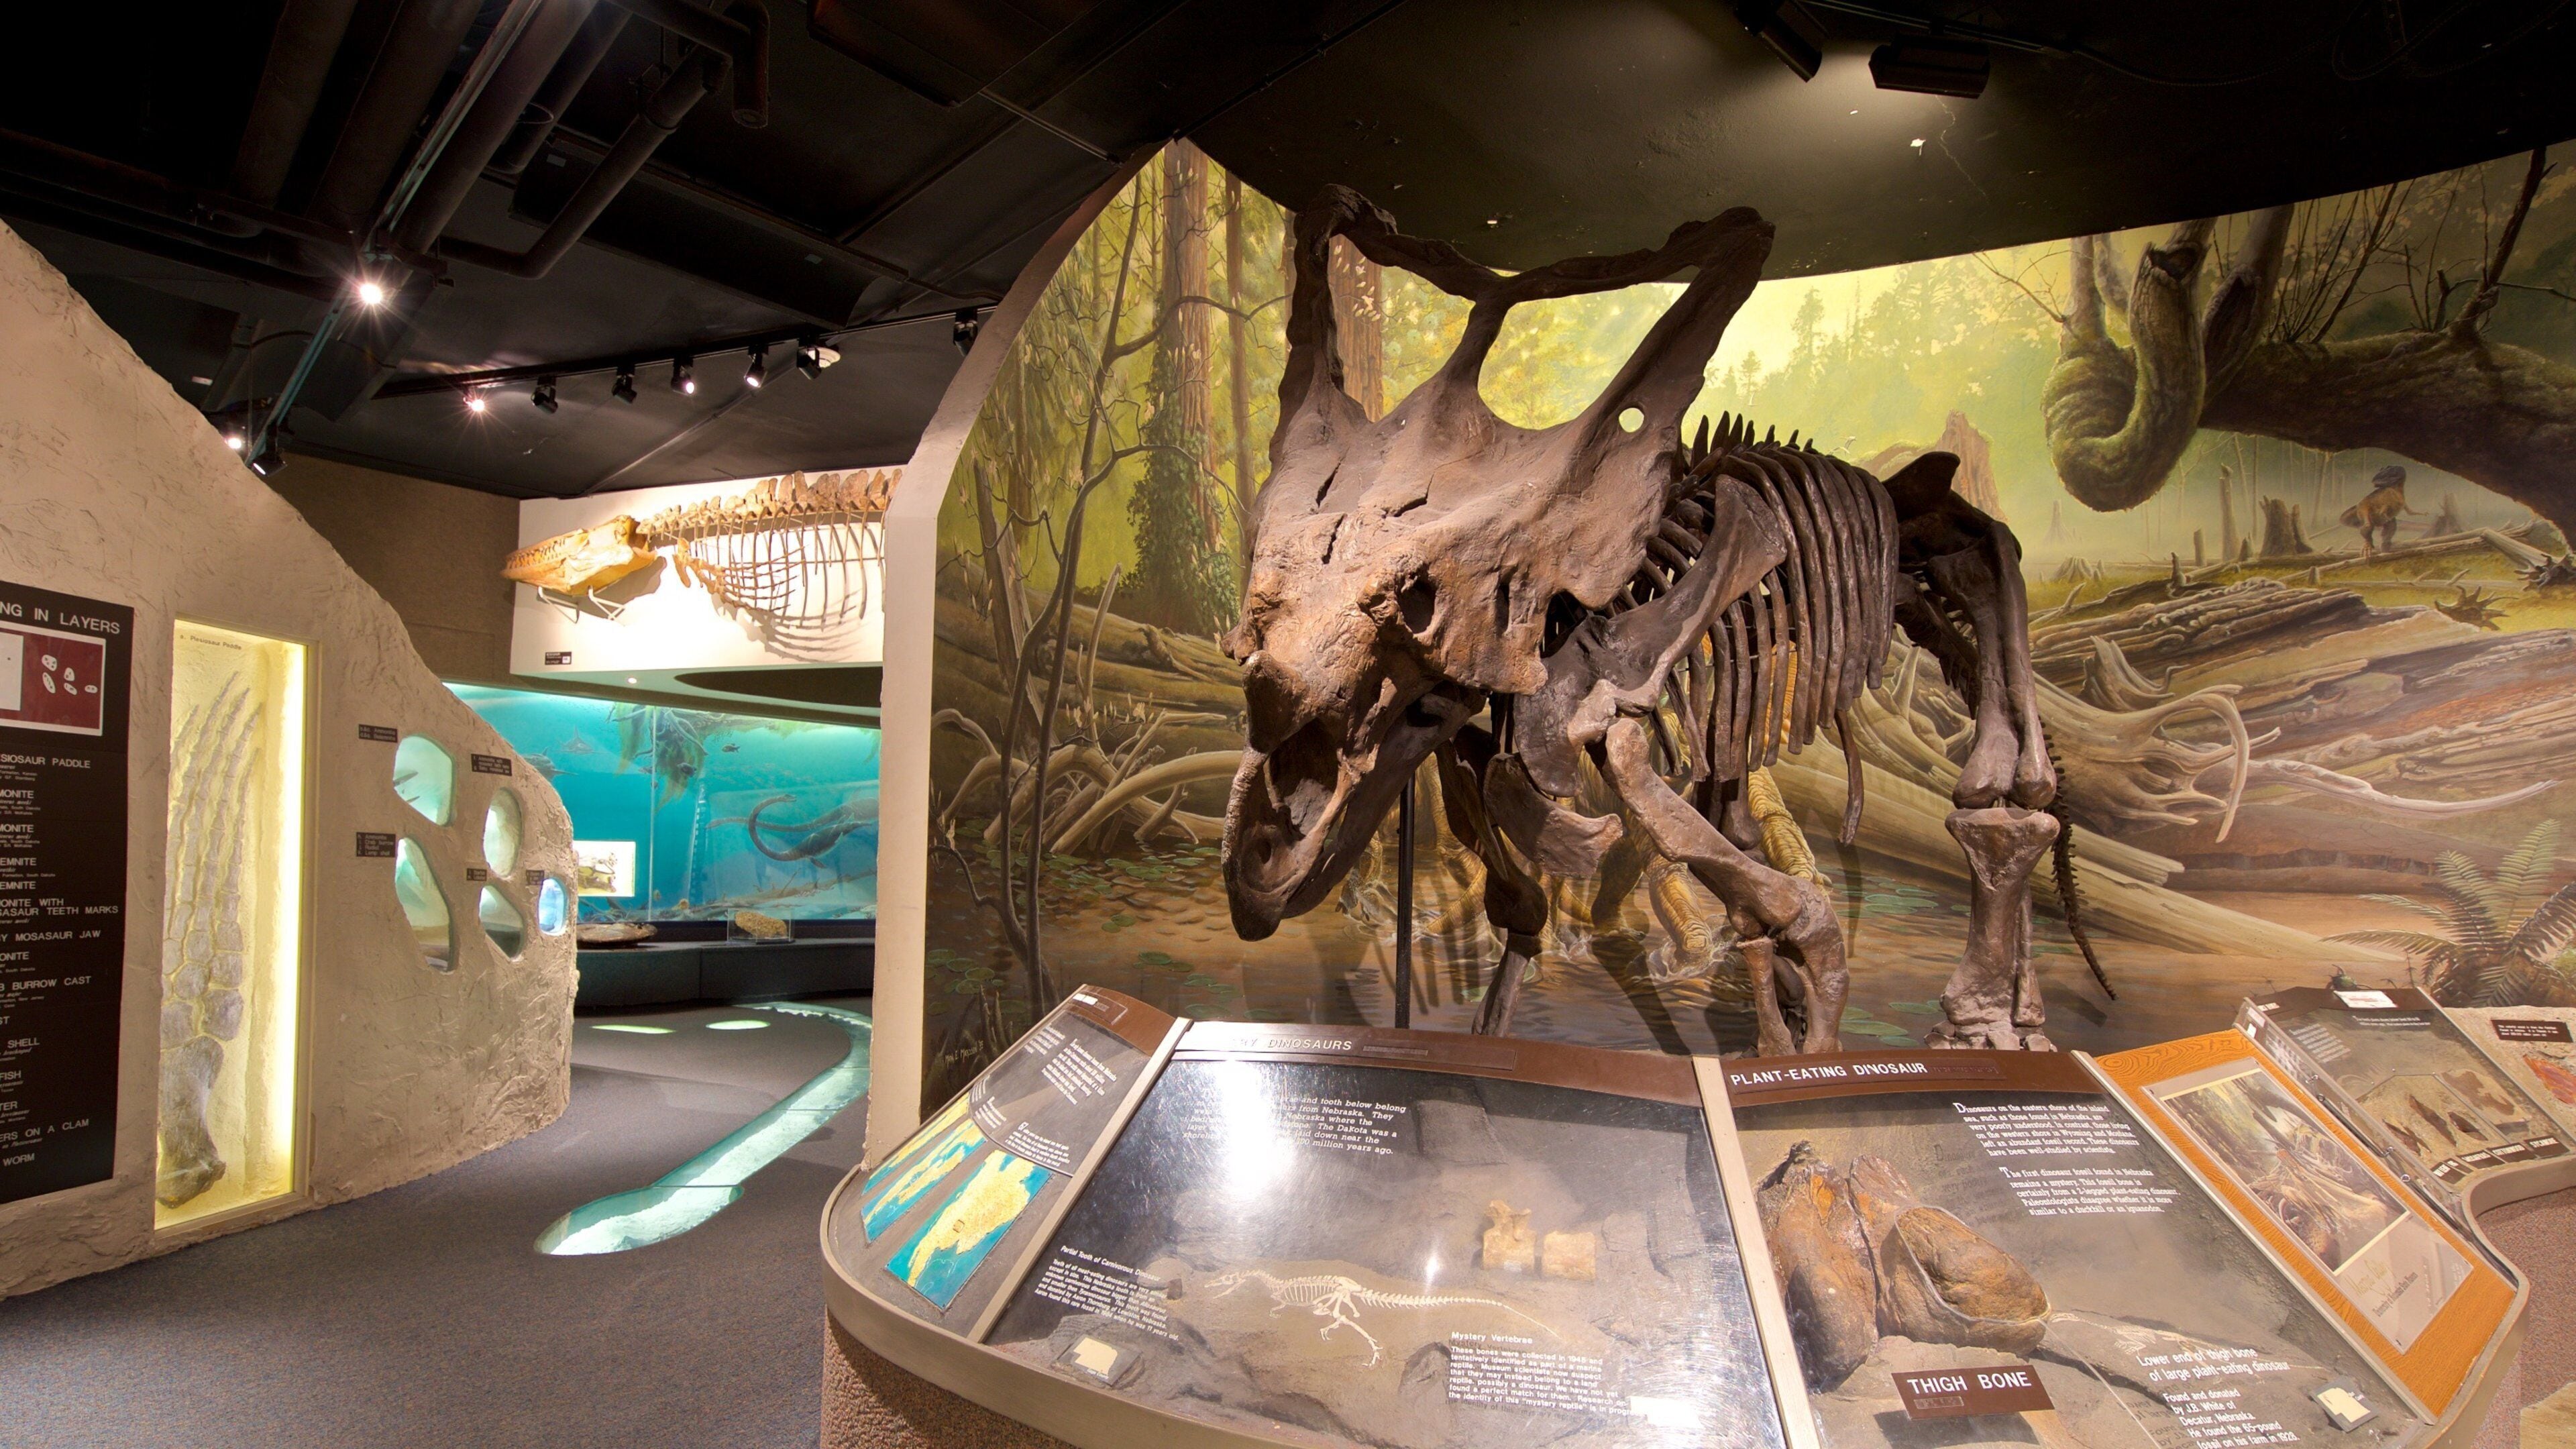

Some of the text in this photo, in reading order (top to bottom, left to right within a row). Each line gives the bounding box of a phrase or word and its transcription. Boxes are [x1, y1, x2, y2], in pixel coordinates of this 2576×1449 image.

[34, 608, 49, 622] IN
[60, 612, 120, 634] LAYERS
[223, 641, 241, 650] Paddle
[0, 753, 91, 769] SIOSAUR PADDLE
[0, 857, 37, 866] EMNITE
[0, 881, 36, 890] EMNITE
[39, 898, 64, 906] WITH
[46, 907, 78, 915] TEETH
[85, 906, 119, 914] MARKS
[15, 931, 72, 941] MOSASAUR
[79, 930, 101, 938] JAW
[12, 979, 57, 991] BURROW
[64, 975, 91, 985] CAST
[7, 1037, 40, 1049] SHELL
[1267, 1038, 1352, 1051] DINOSAURS
[1730, 1063, 1928, 1085] PLANT-EATING DINOSAUR
[1299, 1104, 1393, 1120] from Nebraska. They
[1322, 1097, 1342, 1106] tooth
[1346, 1099, 1372, 1108] below
[1376, 1102, 1406, 1112] belong
[1953, 1102, 1997, 1113] Dinosaurs
[1285, 1112, 1373, 1125] Nebraska where the
[25, 1128, 40, 1137] ON
[47, 1125, 55, 1134] A
[62, 1119, 89, 1130] CLAM
[1294, 1129, 1311, 1137] laid
[1315, 1130, 1338, 1139] down
[1318, 1122, 1334, 1130] The
[1338, 1124, 1367, 1133] DaKota
[1295, 1137, 1311, 1145] 100
[1313, 1140, 1343, 1148] million
[3, 1153, 35, 1166] WORM
[1060, 1245, 1078, 1256] Partial
[1078, 1250, 1093, 1260] Tooth
[1100, 1257, 1134, 1273] Carnivorous
[1134, 1267, 1161, 1280] Dinosaur
[1451, 1332, 1532, 1344] Mystery Vertebrae
[1450, 1353, 1488, 1364] tentatively
[1491, 1356, 1525, 1366] identified
[1476, 1348, 1497, 1356] bones
[1521, 1352, 1556, 1360] collected
[1568, 1355, 1587, 1363] 1945
[2137, 1348, 2257, 1366] Lower end of thigh bone
[1450, 1362, 1474, 1370] reptile.
[1481, 1364, 1511, 1373] Museum
[1514, 1366, 1550, 1375] scientists
[1571, 1372, 1601, 1380] suspect
[1467, 1370, 1483, 1379] they
[1504, 1373, 1532, 1382] instead
[1534, 1375, 1560, 1386] belong
[1580, 1379, 1597, 1387] land
[2150, 1362, 2290, 1381] of large plant-eating dinosaur
[1477, 1380, 1508, 1389] possibly
[1519, 1382, 1552, 1391] dinosaur.
[1570, 1386, 1587, 1394] have
[1907, 1371, 2032, 1394] THIGH BONE
[1449, 1384, 1470, 1392] found
[1550, 1393, 1570, 1401] them.
[1576, 1395, 1613, 1405] Research
[2163, 1387, 2240, 1403] Found and donated
[2171, 1399, 2236, 1415] by J.B. White of
[2180, 1411, 2255, 1426] Decatur, Nebraska.
[2188, 1420, 2282, 1438] He found the 65-pound
[2197, 1438, 2221, 1449] fossil
[2234, 1436, 2248, 1446] his
[2248, 1436, 2268, 1444] farm
[2268, 1434, 2277, 1442] in
[2277, 1432, 2299, 1442] 1928.
